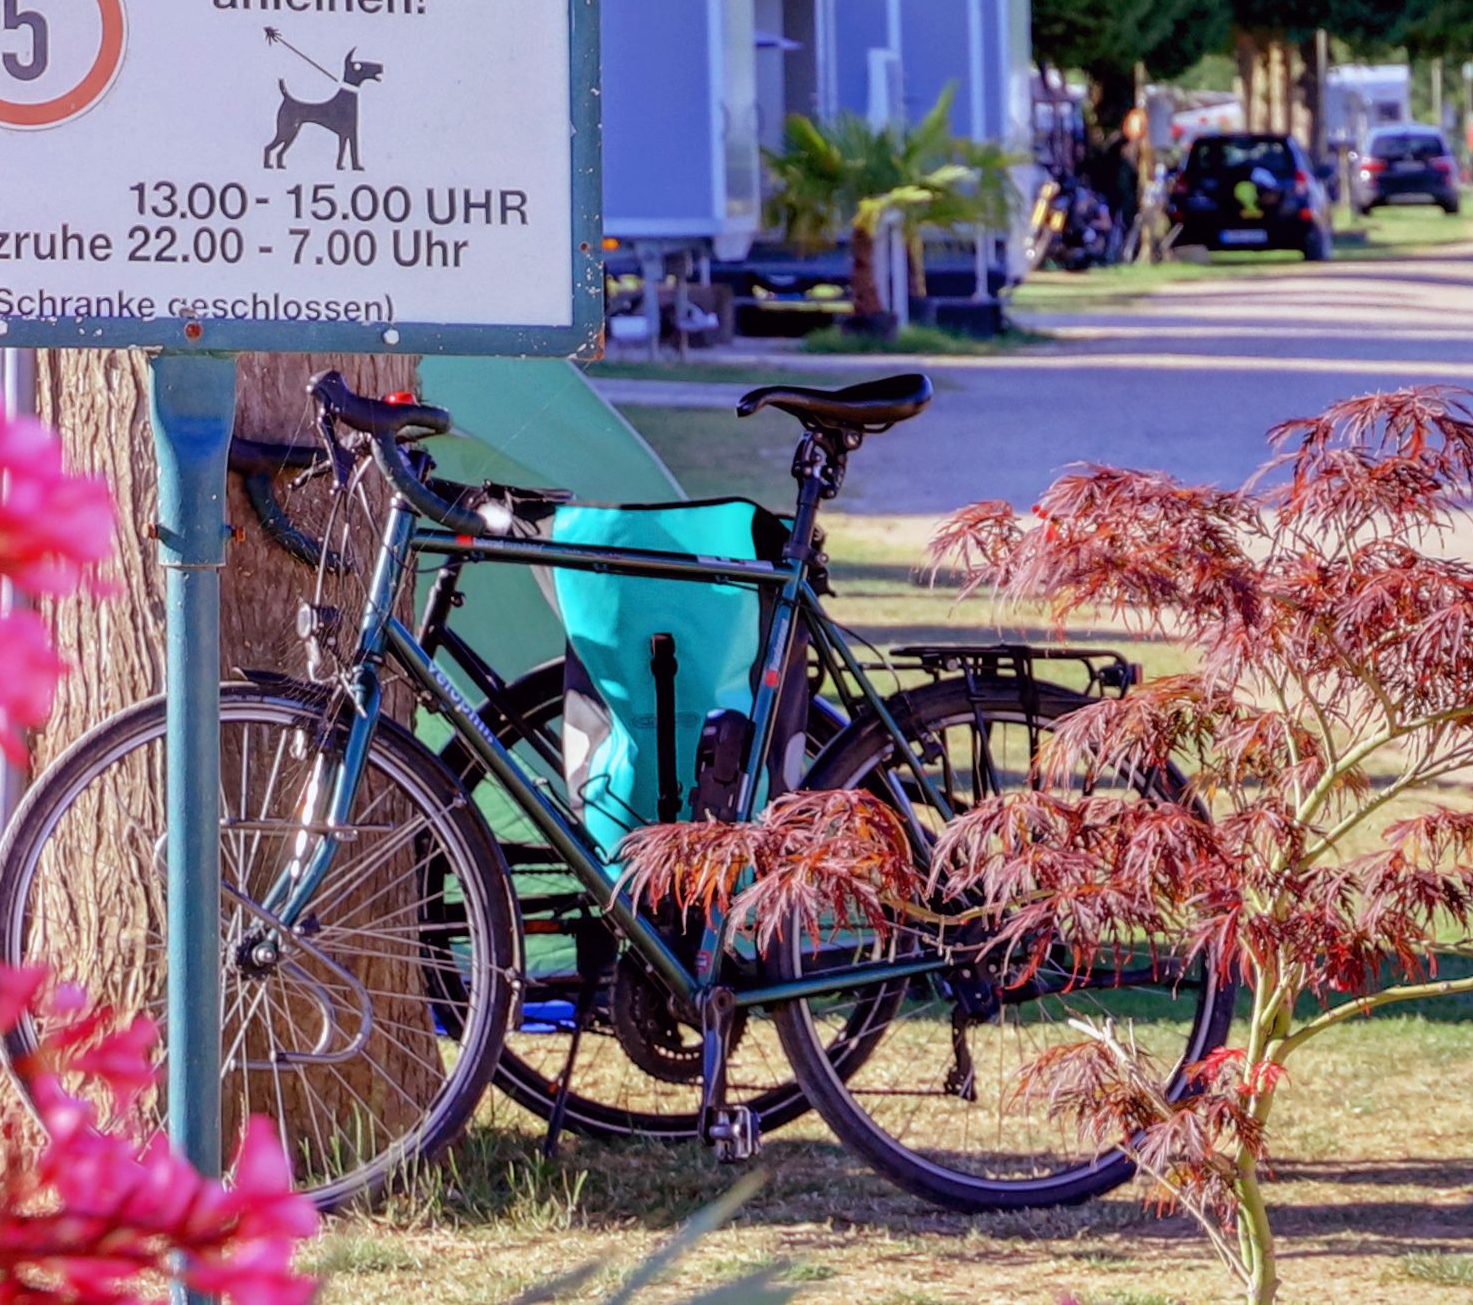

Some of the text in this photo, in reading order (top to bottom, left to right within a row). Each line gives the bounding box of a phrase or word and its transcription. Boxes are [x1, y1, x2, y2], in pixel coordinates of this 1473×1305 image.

[130, 181, 247, 219] 13.00
[287, 185, 411, 222] 15.00
[427, 188, 527, 225] UHR
[128, 226, 243, 263] 22.00
[289, 229, 376, 266] 7.00
[393, 230, 468, 267] Uhr
